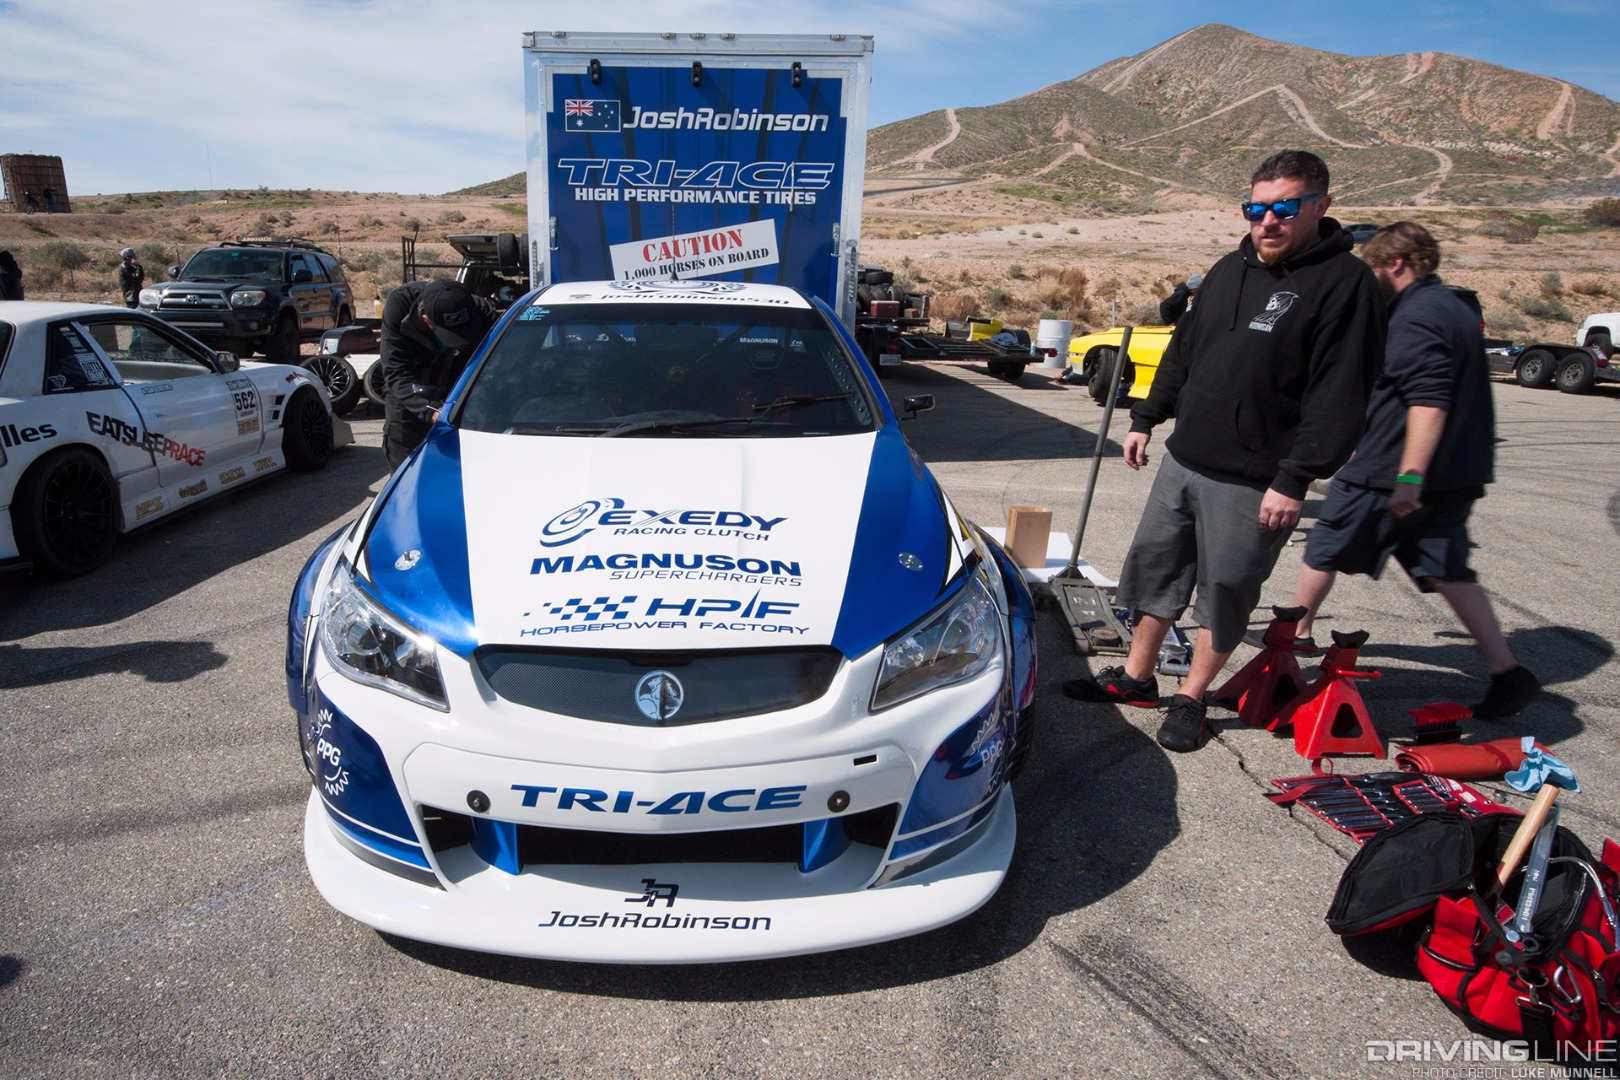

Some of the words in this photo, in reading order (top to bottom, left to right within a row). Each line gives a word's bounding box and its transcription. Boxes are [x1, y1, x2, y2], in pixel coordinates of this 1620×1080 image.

[622, 106, 829, 132] JoshRobinson
[557, 158, 836, 190] TRI-ACE
[575, 187, 628, 201] HIGH
[632, 188, 760, 204] PERFORMANCE
[764, 190, 817, 205] TIRES
[641, 228, 744, 263] CAUTION
[624, 265, 656, 281] 1,000
[659, 257, 706, 277] HORSES
[709, 253, 725, 267] ON
[728, 247, 770, 265] BOARD
[234, 391, 256, 411] 562
[598, 508, 789, 531] EXEDY
[613, 527, 686, 537] RACING
[693, 528, 769, 542] CLUTCH
[529, 553, 802, 577] MAGNUSON
[609, 570, 802, 587] SUPERCHARGERS
[520, 621, 687, 637] HORSEPOWER
[699, 621, 810, 635] FACTORY
[317, 738, 341, 767] PPG
[511, 784, 807, 815] TRI-ACE
[624, 878, 679, 908] JR
[538, 911, 771, 931] JoshRobinson
